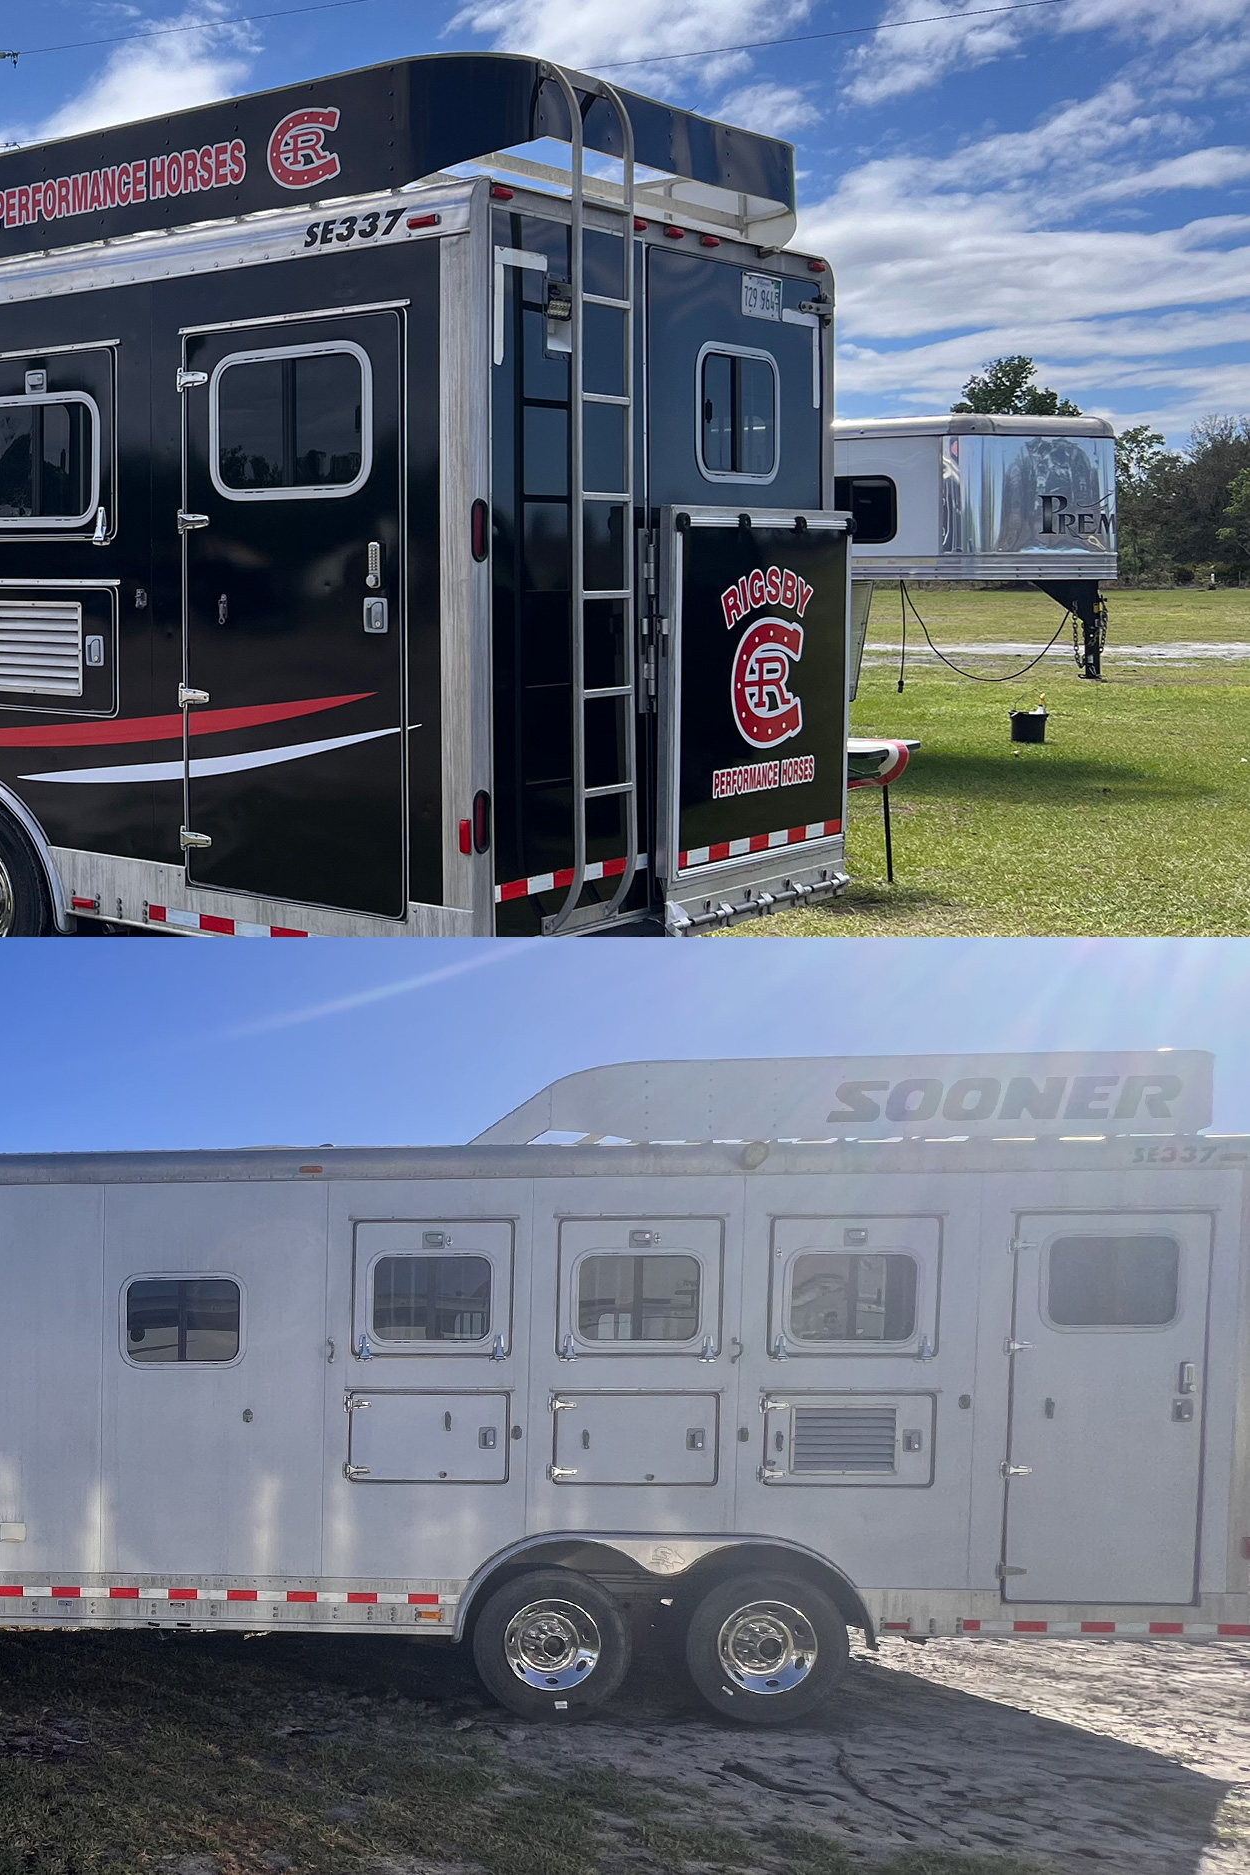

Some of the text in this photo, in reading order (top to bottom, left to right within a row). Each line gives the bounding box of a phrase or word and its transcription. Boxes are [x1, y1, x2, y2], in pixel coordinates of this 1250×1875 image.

[150, 138, 246, 200] HORSES
[304, 207, 408, 248] SE337
[744, 285, 758, 308] 729
[760, 289, 775, 312] 964
[721, 566, 813, 630] RIGSBY
[713, 755, 814, 799] PERFORMANCE HORSES
[826, 1075, 1182, 1123] SOONER
[1132, 1146, 1218, 1163] SE337
